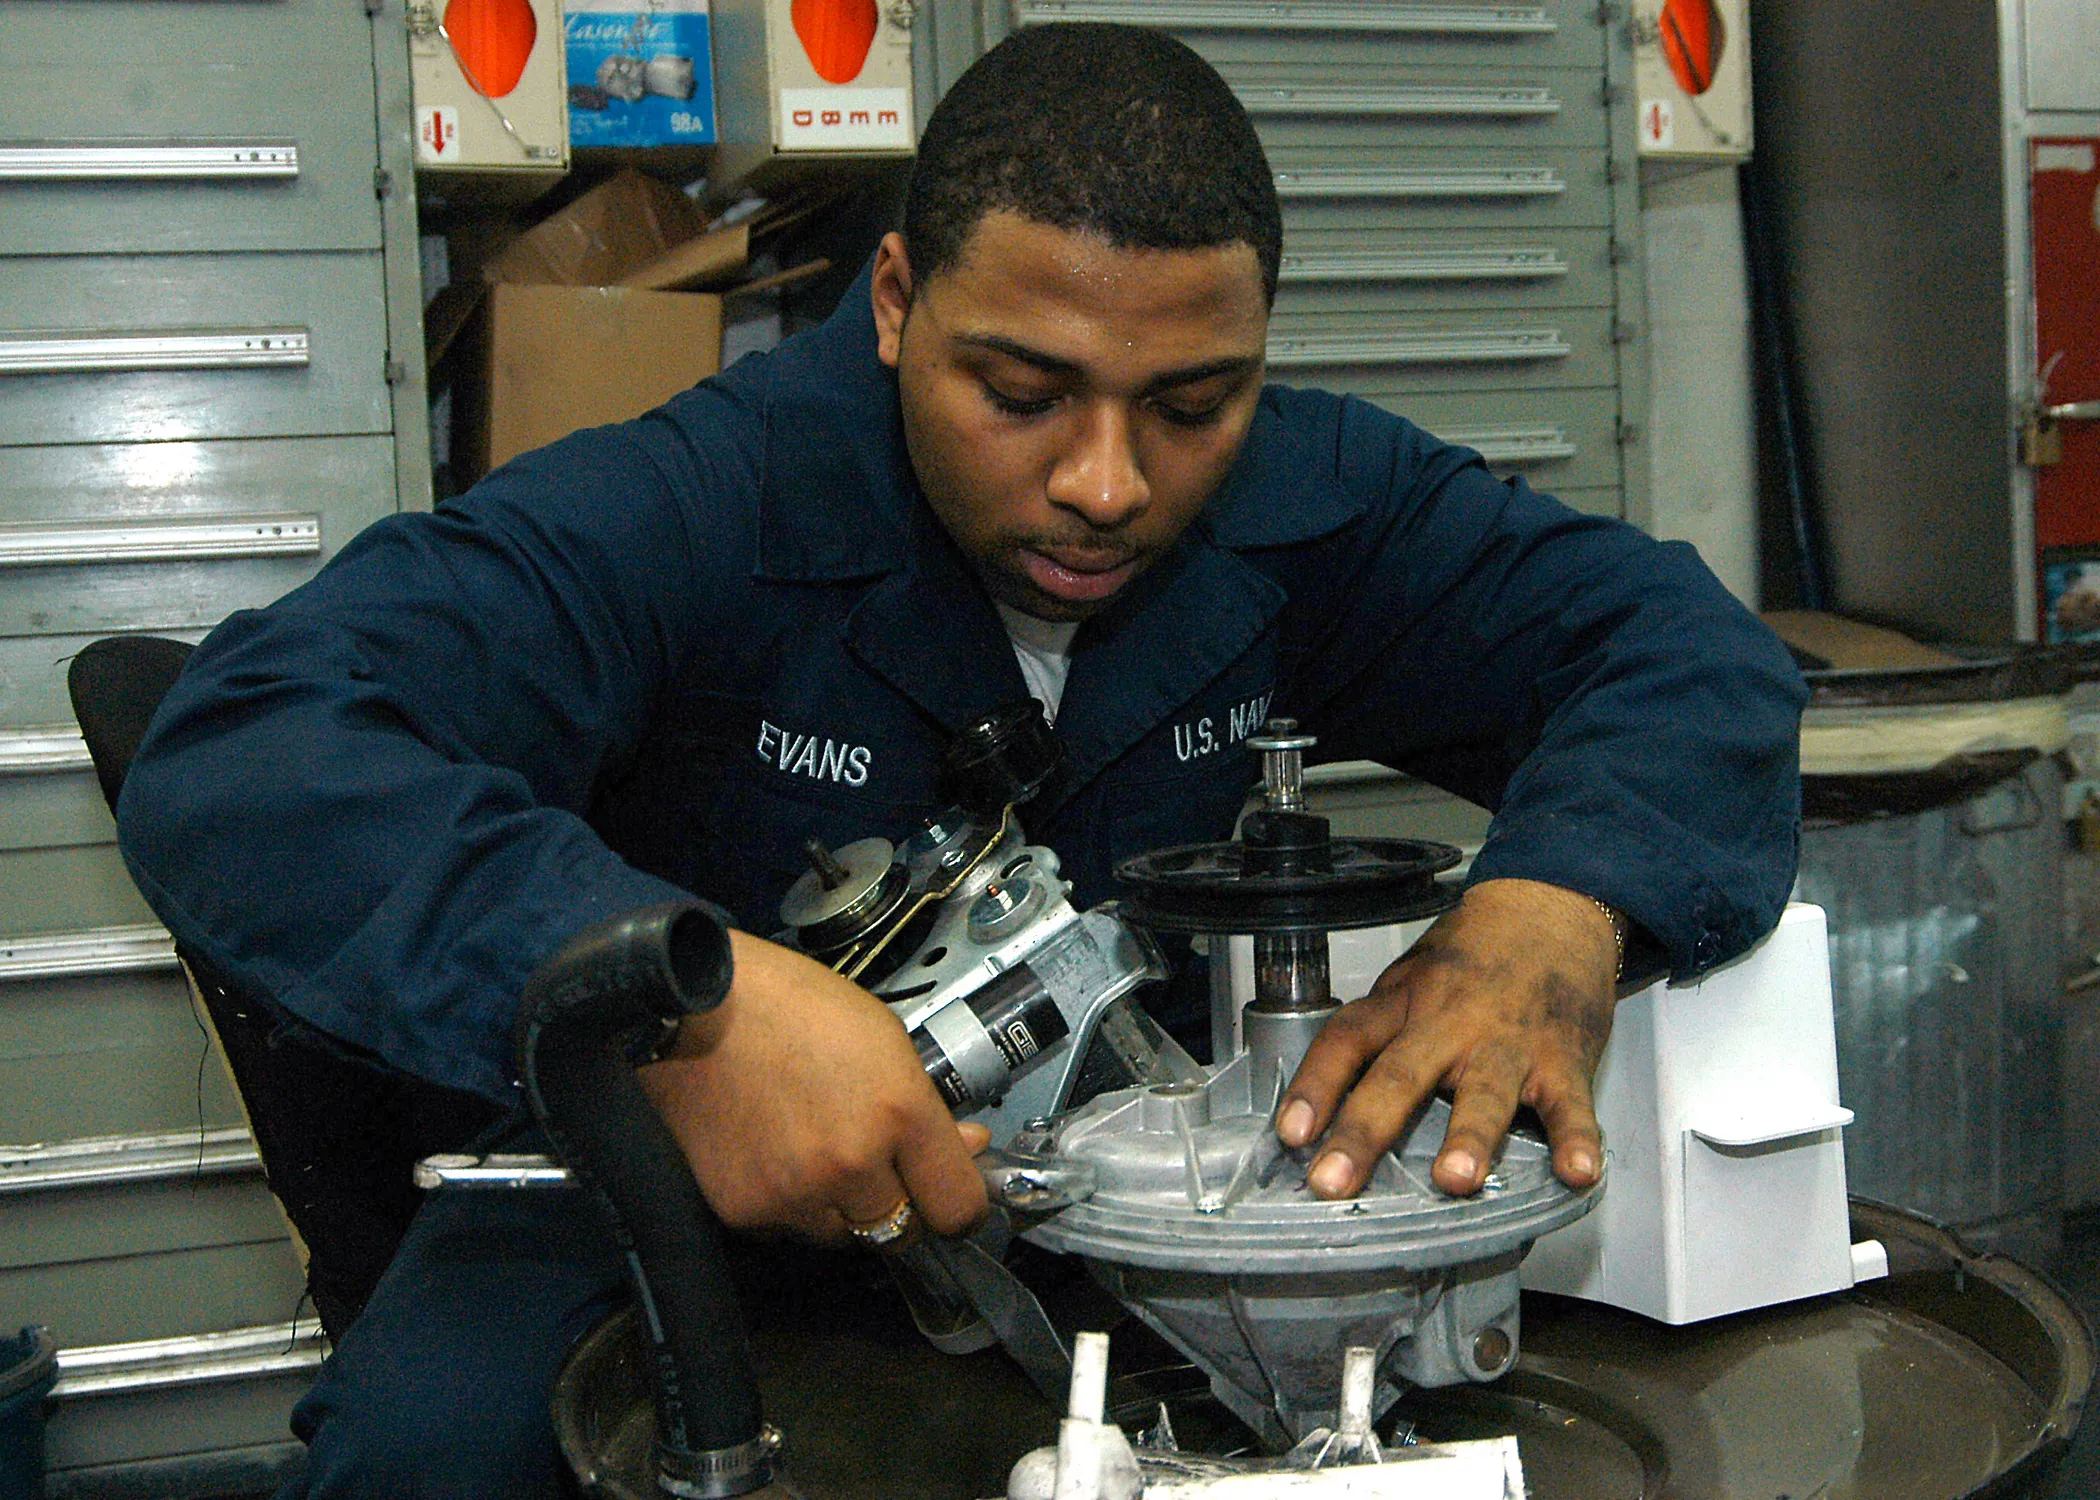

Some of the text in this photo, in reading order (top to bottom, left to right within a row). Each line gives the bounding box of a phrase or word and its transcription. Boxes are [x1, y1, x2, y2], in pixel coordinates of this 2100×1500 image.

[670, 111, 703, 133] 98A
[757, 720, 871, 787] EVANS
[1174, 690, 1275, 761] U.S. NAV
